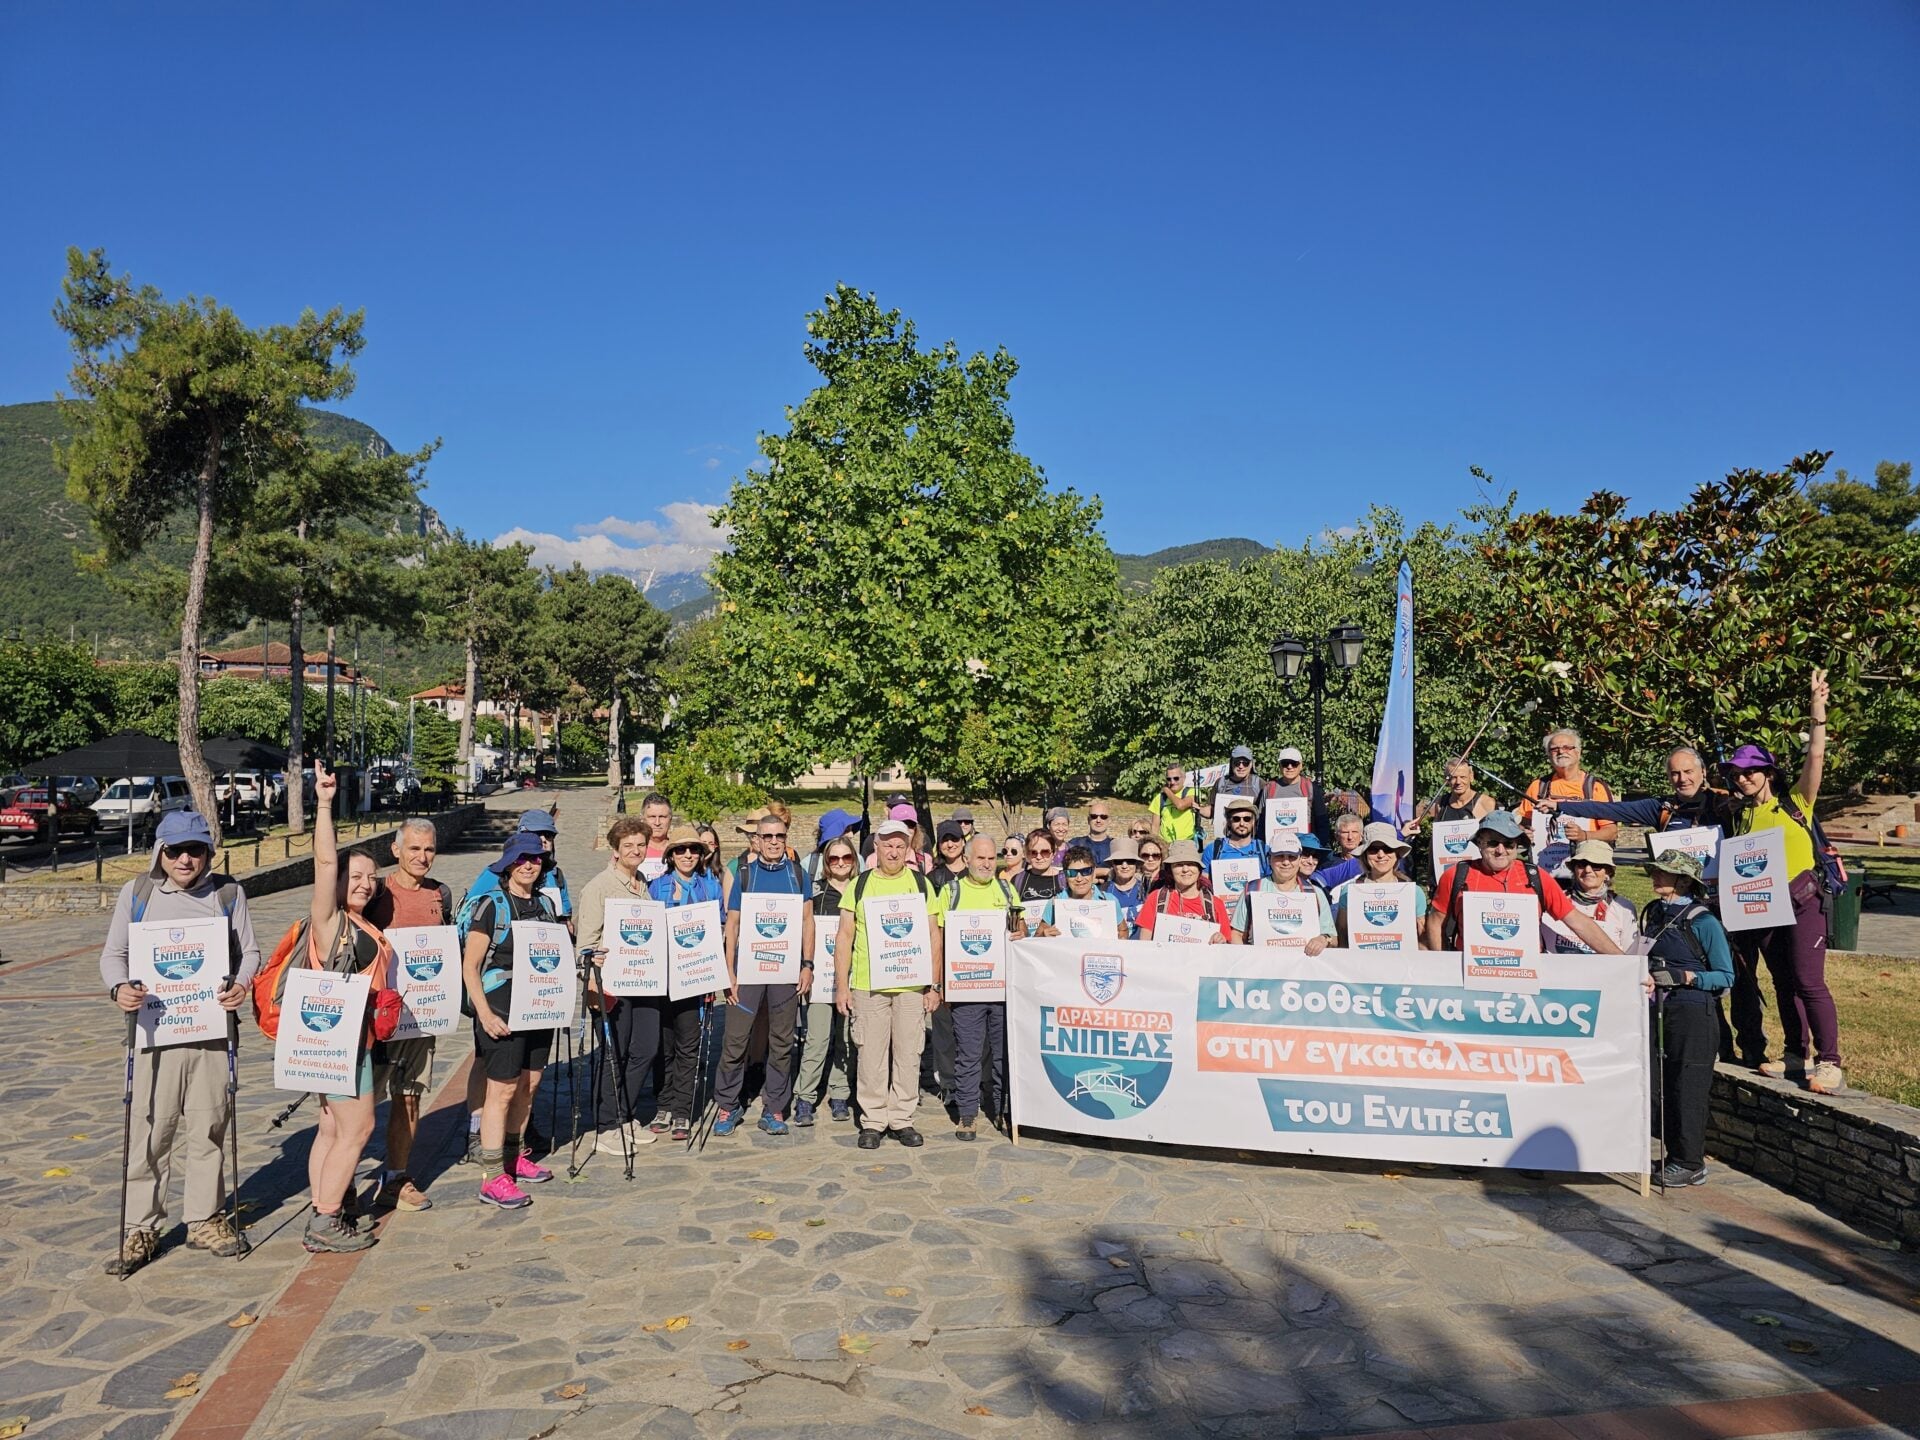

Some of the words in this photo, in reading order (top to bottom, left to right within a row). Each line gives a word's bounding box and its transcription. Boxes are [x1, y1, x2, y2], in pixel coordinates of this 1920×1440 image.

[1733, 879, 1772, 893] ΖΩΝΤΑΝΟΣ
[1739, 893, 1770, 901] ΕΝΙΠΕΑΣ
[1746, 903, 1766, 912] ΤΩΡΑ
[880, 914, 913, 924] ΕΝΙΠΕΑΣ
[1481, 912, 1520, 925] ΕΝΙΠΕΑΣ
[620, 919, 653, 931] ΕΝΙΠΕΑΣ
[960, 930, 992, 941] ΕΝΙΠΕΑΣ
[619, 946, 650, 956] Ενιπέας:
[752, 942, 787, 952] ΖΩΝΤΑΝΟΣ
[880, 944, 922, 960] καταστροφή
[1487, 948, 1515, 956] γεφύρια
[153, 948, 205, 962] ΕΝΙΠΕΑΣ
[405, 951, 443, 964] ΕΝΙΠΕΑΣ
[898, 956, 912, 964] τότε
[1495, 957, 1519, 965] Ενιπέα
[628, 956, 655, 967] αρκετά
[622, 967, 632, 975] με
[633, 968, 646, 977] την
[884, 964, 909, 973] ευθύνη
[1471, 967, 1496, 976] ζητούν
[1498, 969, 1533, 978] φροντίδα
[529, 974, 559, 985] Ενιπέας:
[613, 979, 659, 989] εγκατάληψη
[155, 981, 201, 993] Ενιπέας:
[407, 982, 441, 993] Ενιπέας:
[538, 984, 564, 997] αρκετά
[147, 987, 215, 1010] καταστροφή
[417, 990, 447, 1005] αρκετά
[532, 999, 542, 1007] με
[543, 999, 555, 1008] την
[176, 1003, 199, 1014] τότε
[301, 995, 344, 1014] ΕΝΙΠΕΑΣ
[1217, 980, 1271, 1011] Να
[1280, 981, 1386, 1018] δοθεί
[1395, 987, 1466, 1022] ένα
[1474, 992, 1592, 1034] τέλος
[411, 1007, 421, 1016] με
[422, 1008, 437, 1017] την
[521, 1010, 566, 1022] εγκατάληψη
[154, 1014, 193, 1026] ευθύνη
[399, 1017, 449, 1032] εγκατάληψη
[1058, 1008, 1118, 1027] ΔΡΑΣΗ
[1121, 1011, 1171, 1030] ΤΩΡΑ
[173, 1024, 208, 1035] σήμερα
[1040, 1005, 1172, 1059] ΕΝΙΠΕΑΣ
[296, 1034, 329, 1046] Ενιπέας:
[300, 1049, 347, 1058] καταστροφή
[288, 1057, 301, 1065] δεν
[303, 1058, 321, 1068] είναι
[322, 1059, 349, 1071] άλλοθι
[1207, 1036, 1295, 1069] στην
[1305, 1038, 1565, 1085] εγκατάλειψη
[284, 1069, 296, 1077] για
[298, 1070, 347, 1082] εγκατάλειψη
[1283, 1098, 1352, 1126] του
[1363, 1094, 1502, 1136] Ενιπέα
